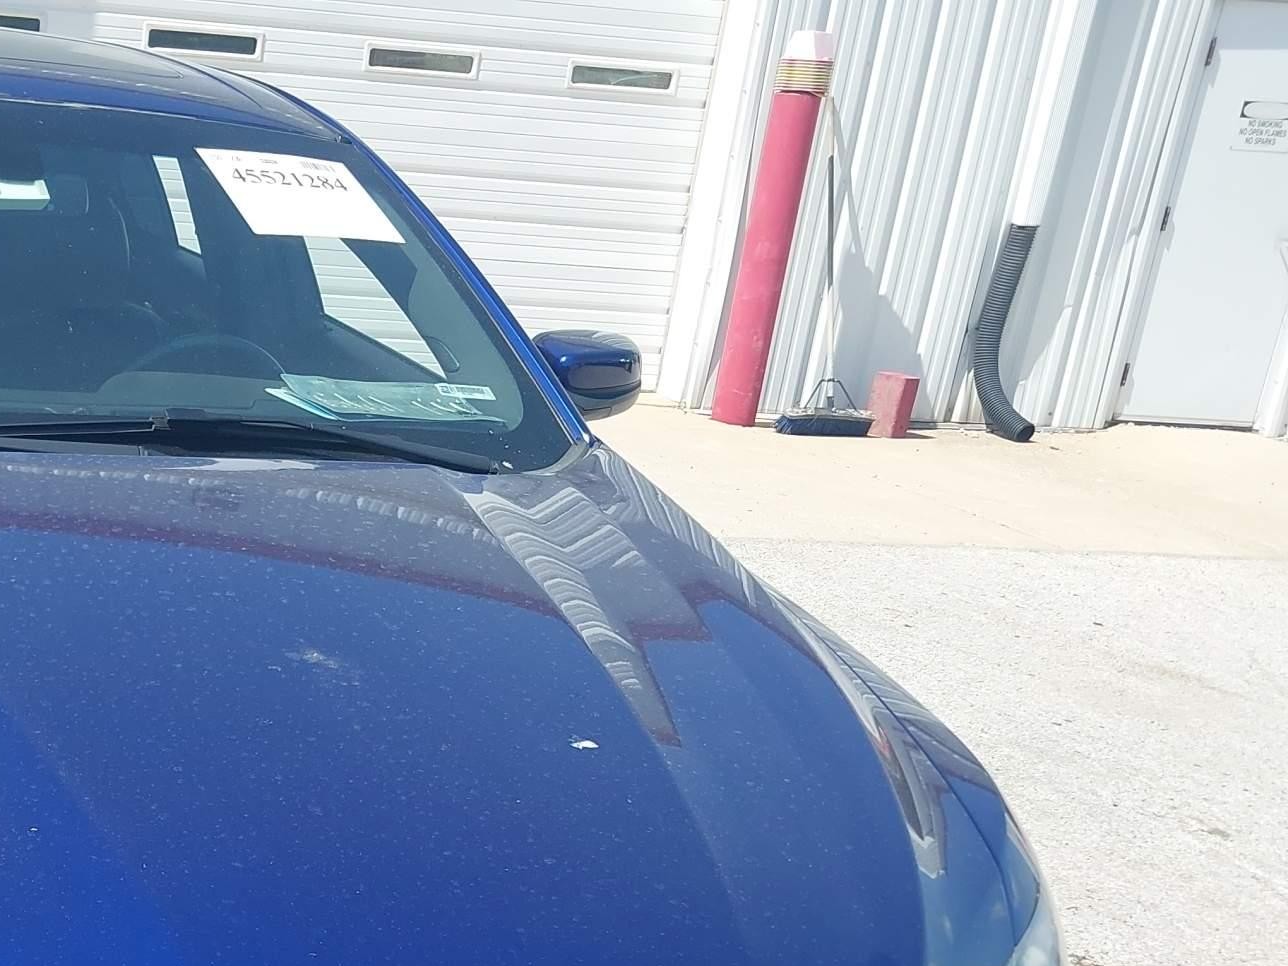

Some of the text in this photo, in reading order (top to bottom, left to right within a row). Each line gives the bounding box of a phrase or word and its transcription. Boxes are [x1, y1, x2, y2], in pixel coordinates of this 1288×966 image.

[1239, 128, 1247, 136] NO
[1264, 129, 1287, 137] FLAMES
[1254, 137, 1276, 145] SPARKS
[232, 168, 348, 191] 45521284
